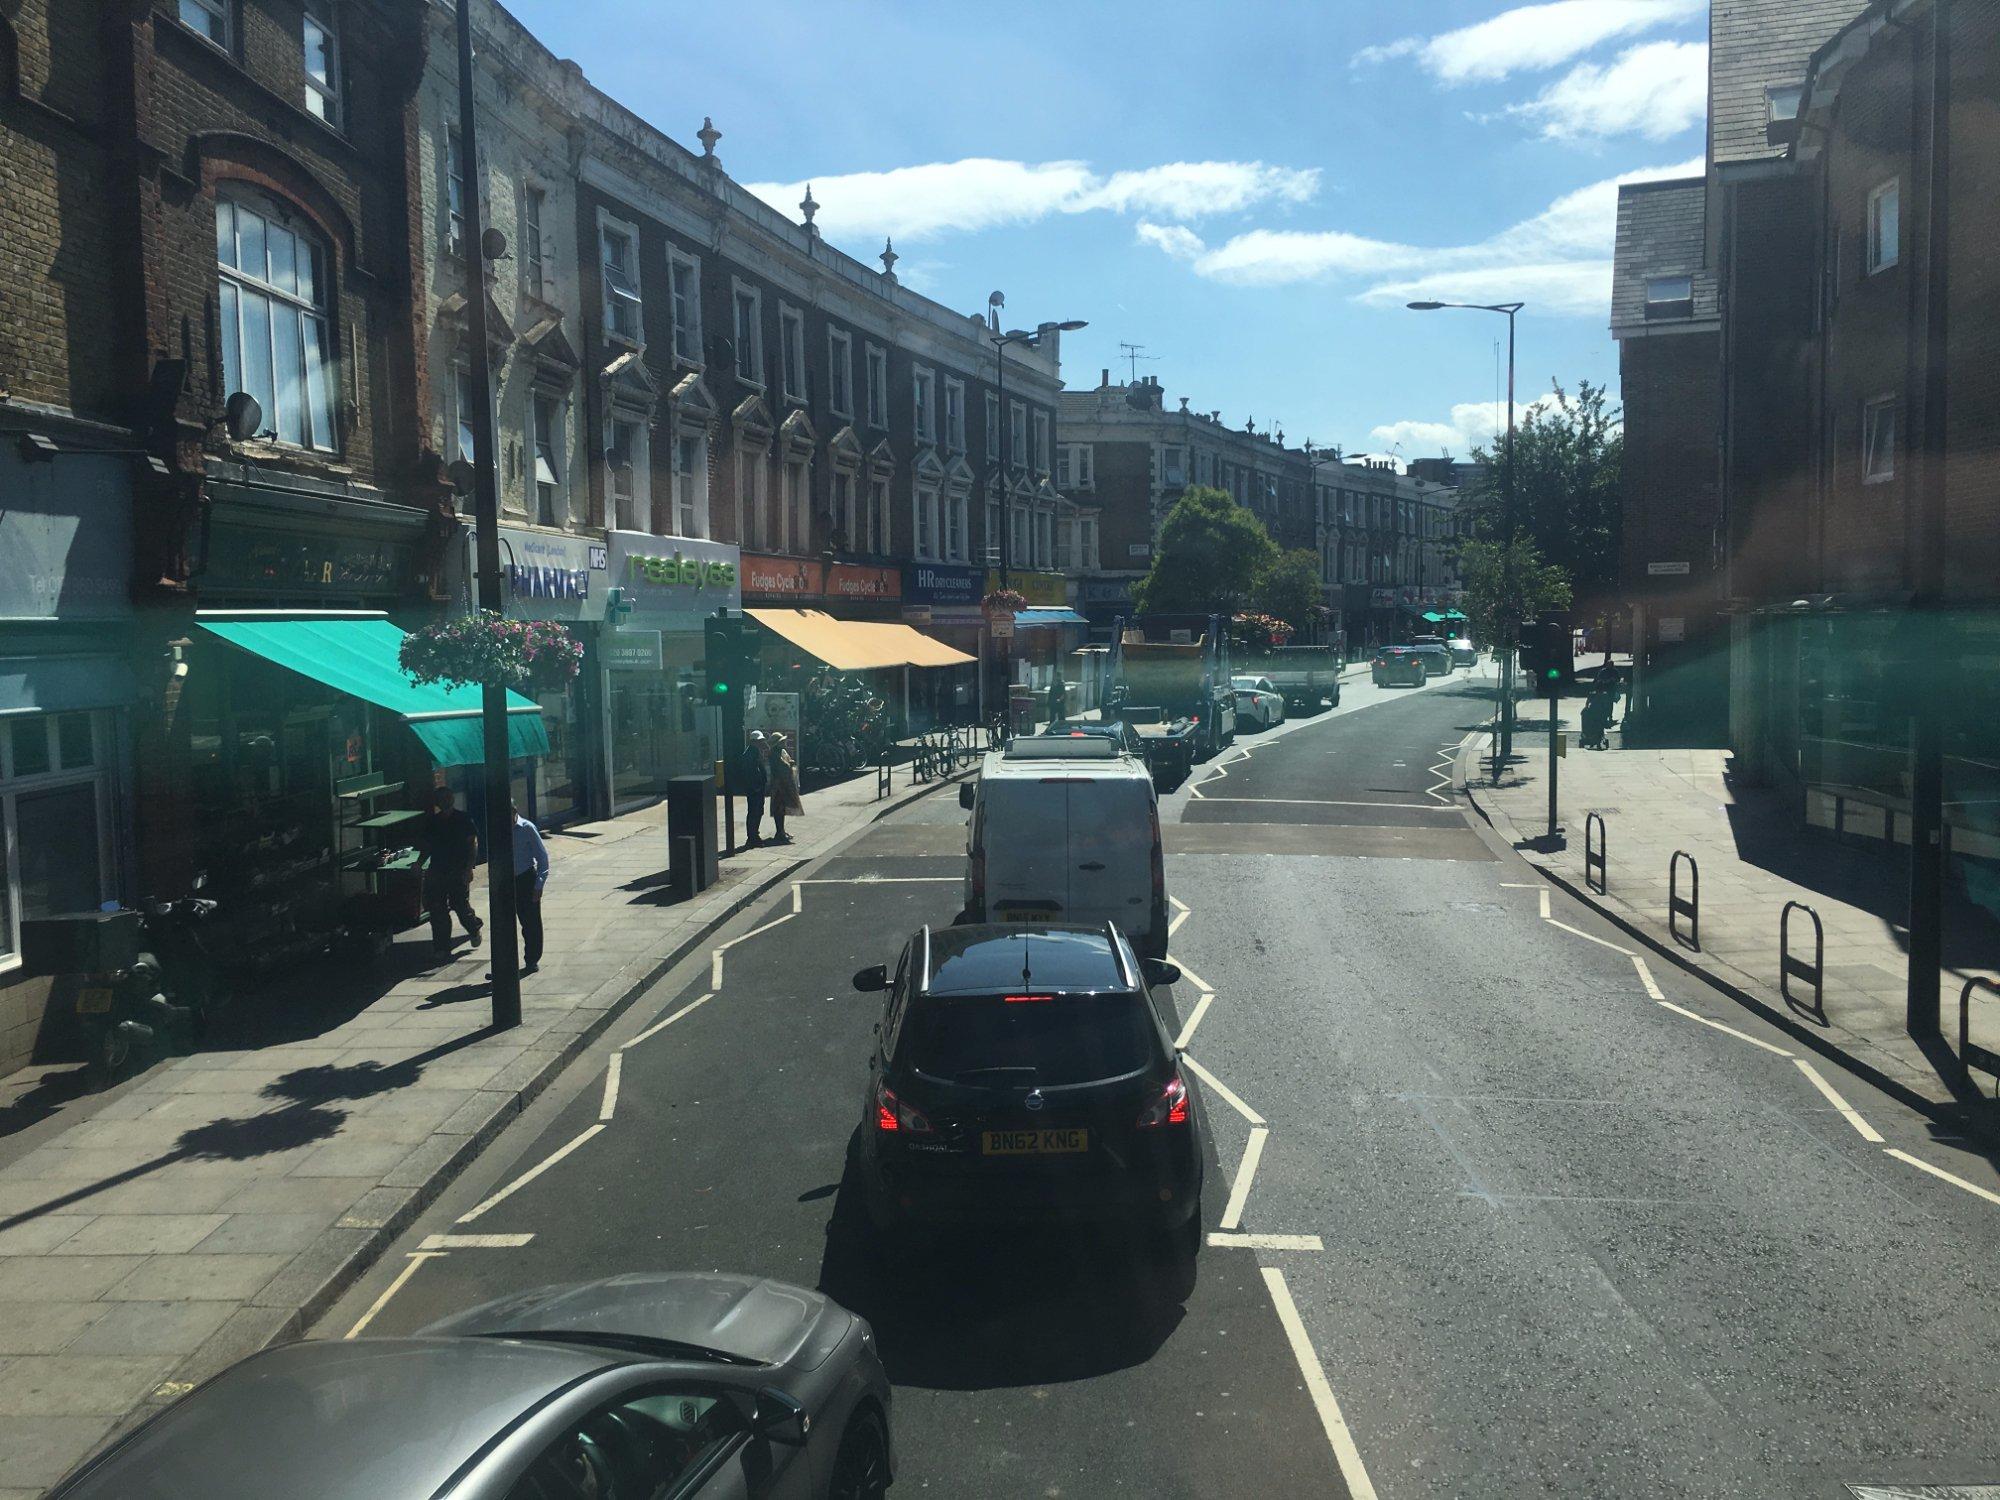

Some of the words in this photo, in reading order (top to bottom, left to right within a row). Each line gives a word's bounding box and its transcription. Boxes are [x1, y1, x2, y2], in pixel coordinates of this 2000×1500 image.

[590, 547, 606, 568] NHS
[627, 552, 736, 590] realeyes
[751, 571, 776, 591] Fudges
[918, 569, 935, 588] HR
[504, 564, 589, 599] PHARMACY
[839, 578, 859, 594] Fudges
[990, 1132, 1038, 1151] BN62
[1043, 1131, 1080, 1149] KNG
